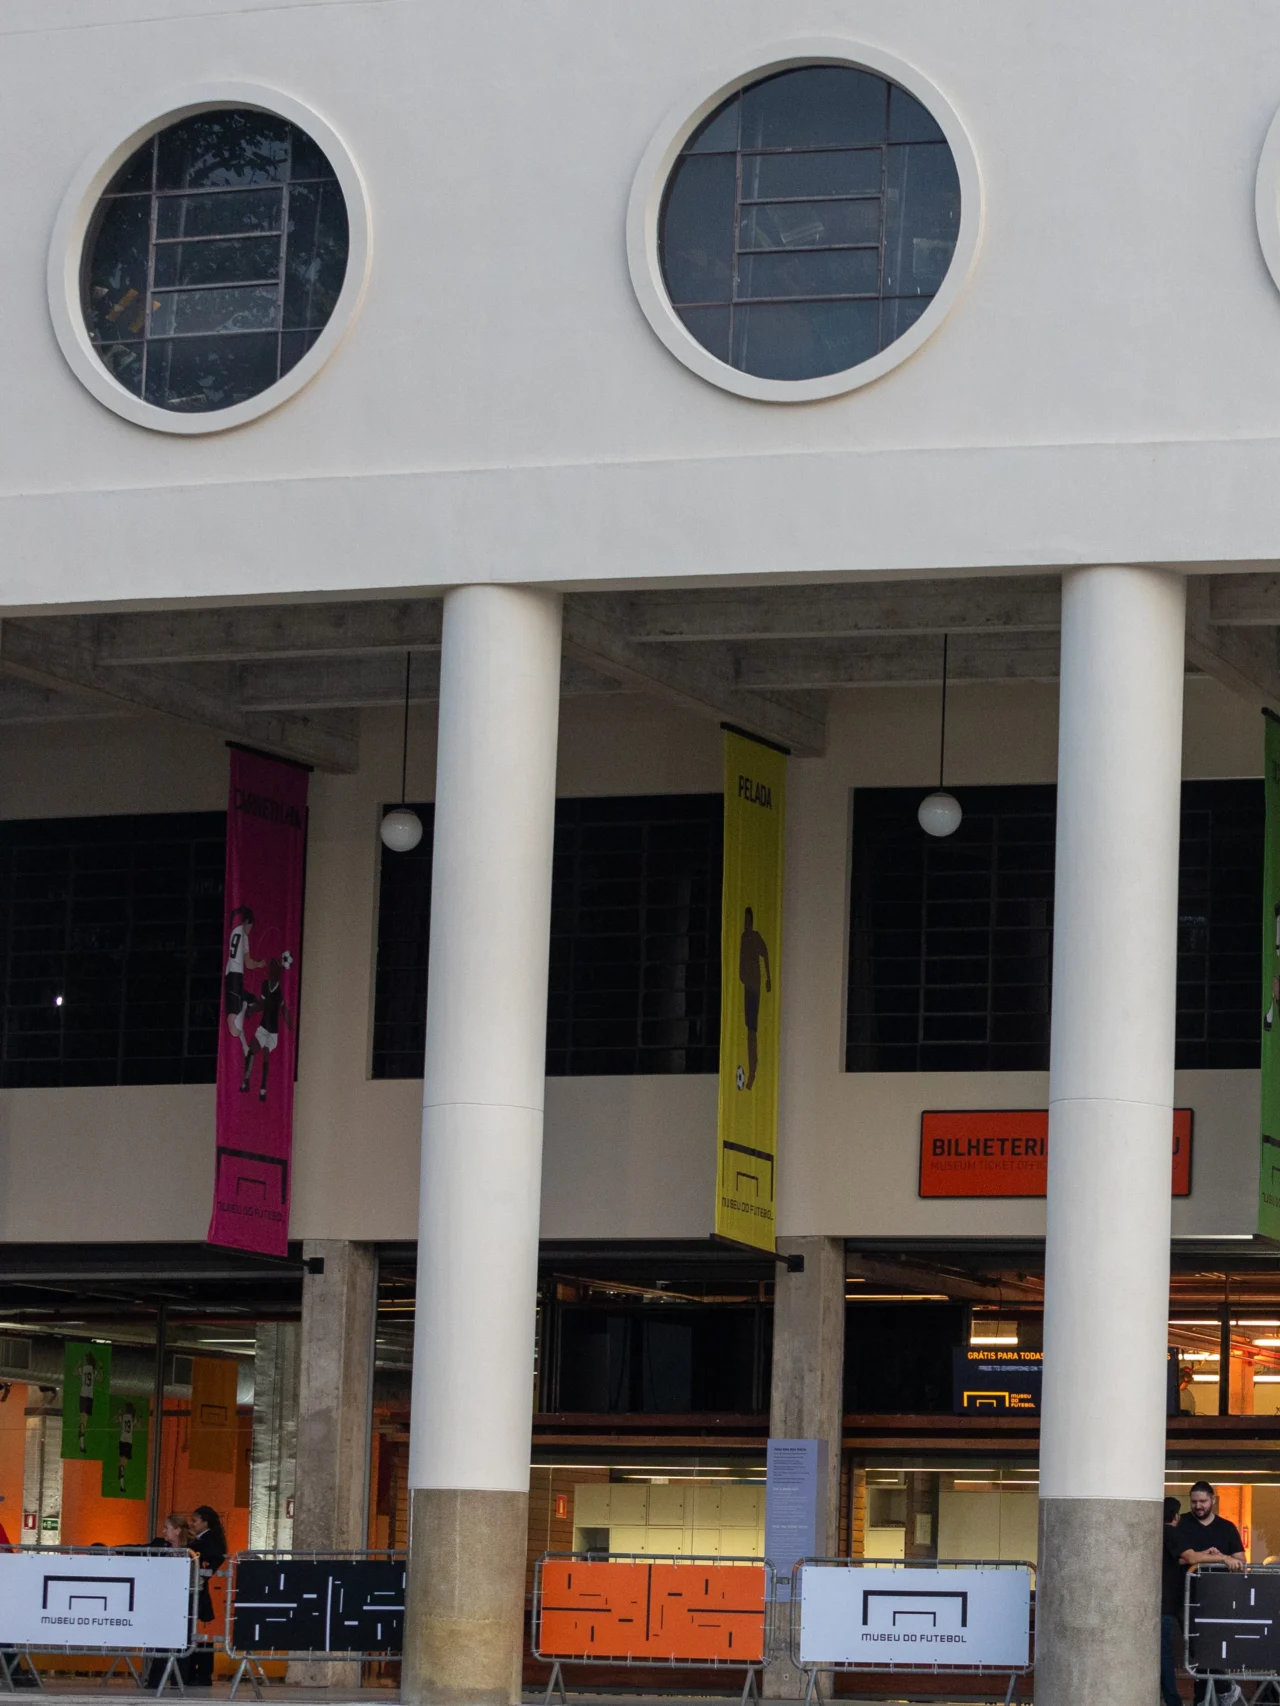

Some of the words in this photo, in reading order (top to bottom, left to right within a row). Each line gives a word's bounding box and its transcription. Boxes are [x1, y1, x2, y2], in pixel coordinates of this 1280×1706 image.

[738, 775, 772, 810] PELADA
[230, 933, 241, 959] 9
[932, 1137, 1045, 1156] BILHETERI
[1017, 1160, 1047, 1171] OFFIC
[967, 1350, 996, 1360] GRÁTIS
[997, 1351, 1019, 1360] PARA
[83, 1371, 92, 1387] 19
[41, 1616, 75, 1625] MUSEU
[77, 1617, 90, 1626] DO
[92, 1617, 133, 1627] FUTEBOL
[861, 1633, 900, 1642] MUSEU
[903, 1633, 917, 1642] DO
[920, 1634, 967, 1643] FUTEBOL
